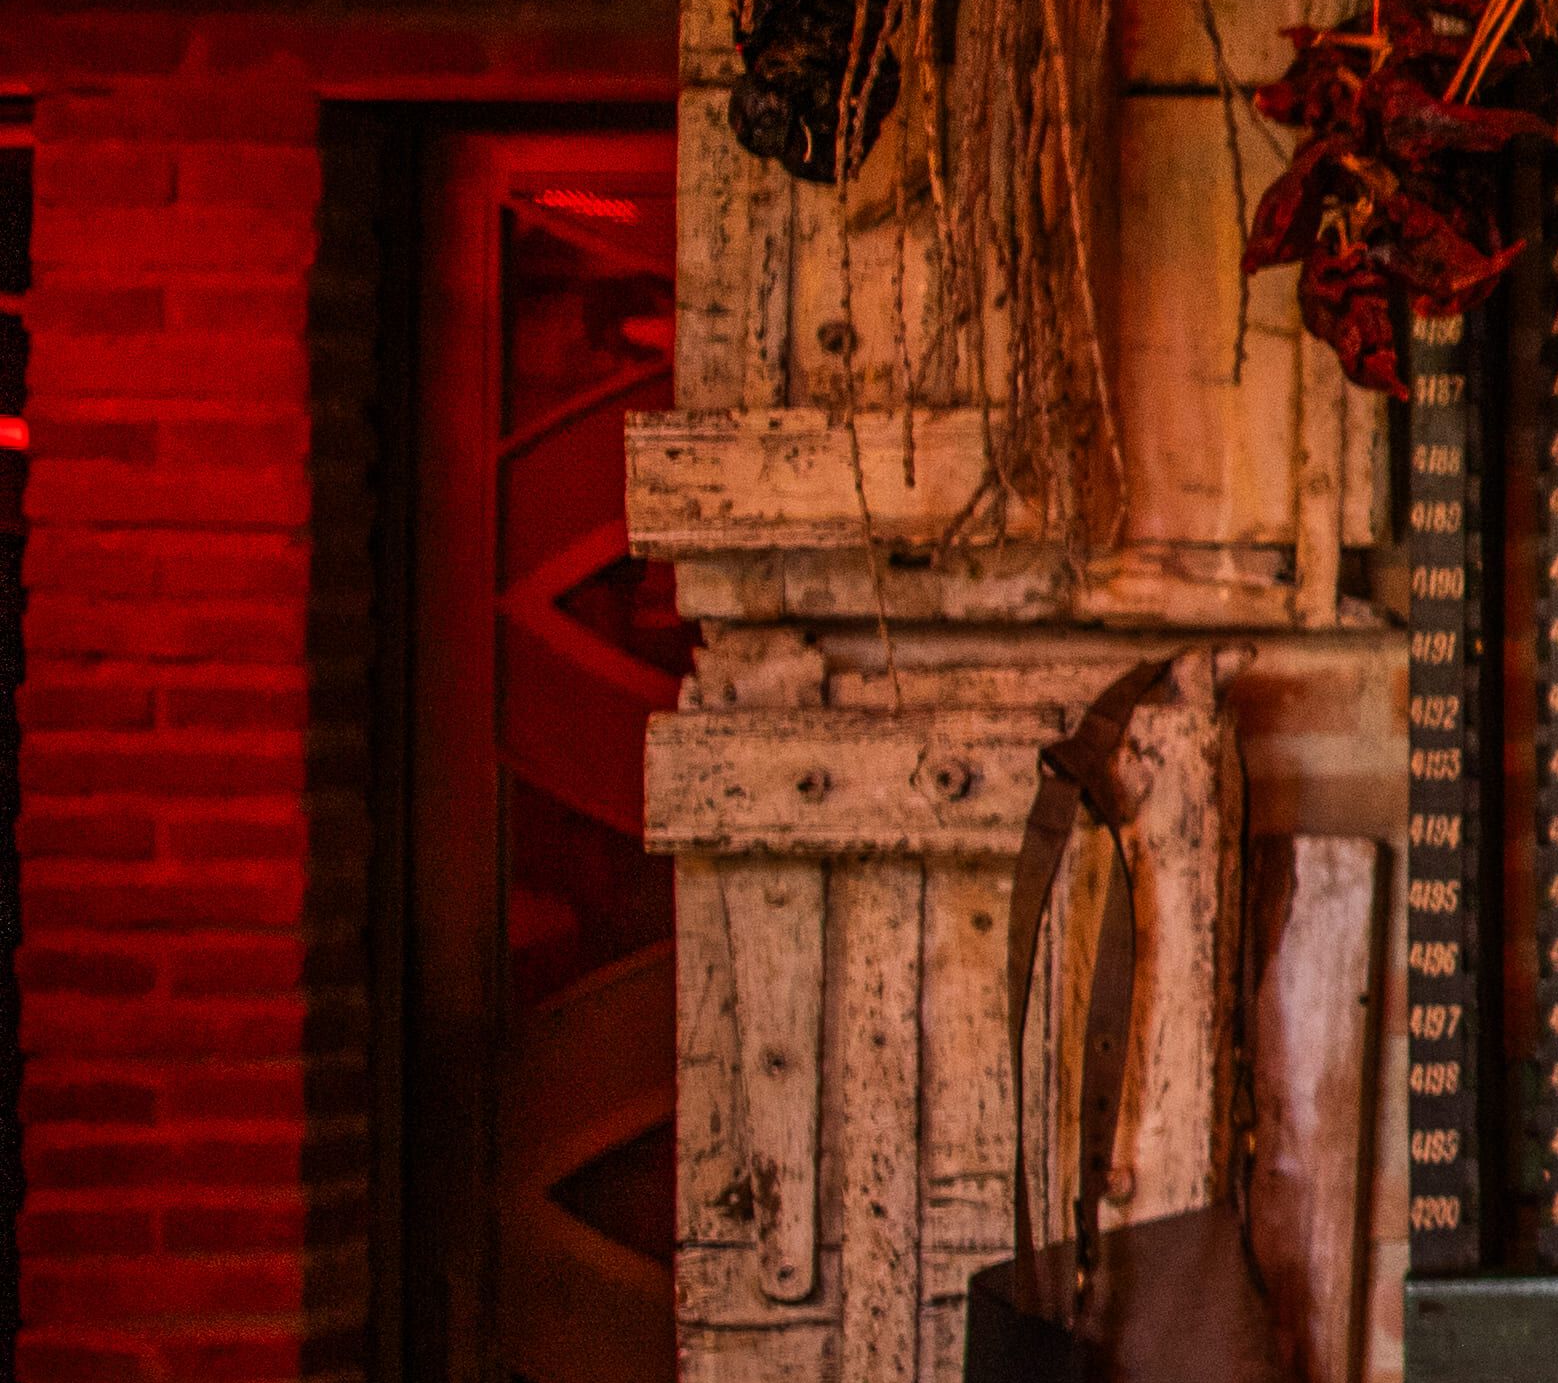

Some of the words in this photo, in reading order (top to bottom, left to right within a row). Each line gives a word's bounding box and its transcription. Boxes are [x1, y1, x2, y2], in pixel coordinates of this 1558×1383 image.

[1409, 631, 1458, 664] 4191
[1409, 694, 1461, 731] 4192
[1409, 747, 1462, 780] 4193
[1409, 815, 1462, 848] 4194
[1409, 879, 1460, 913] 4195
[1409, 941, 1460, 977] 4196
[1409, 1004, 1463, 1039] 4197
[1409, 1061, 1460, 1095] 4198
[1409, 1129, 1459, 1163] 4199
[1409, 1196, 1460, 1229] 4200
